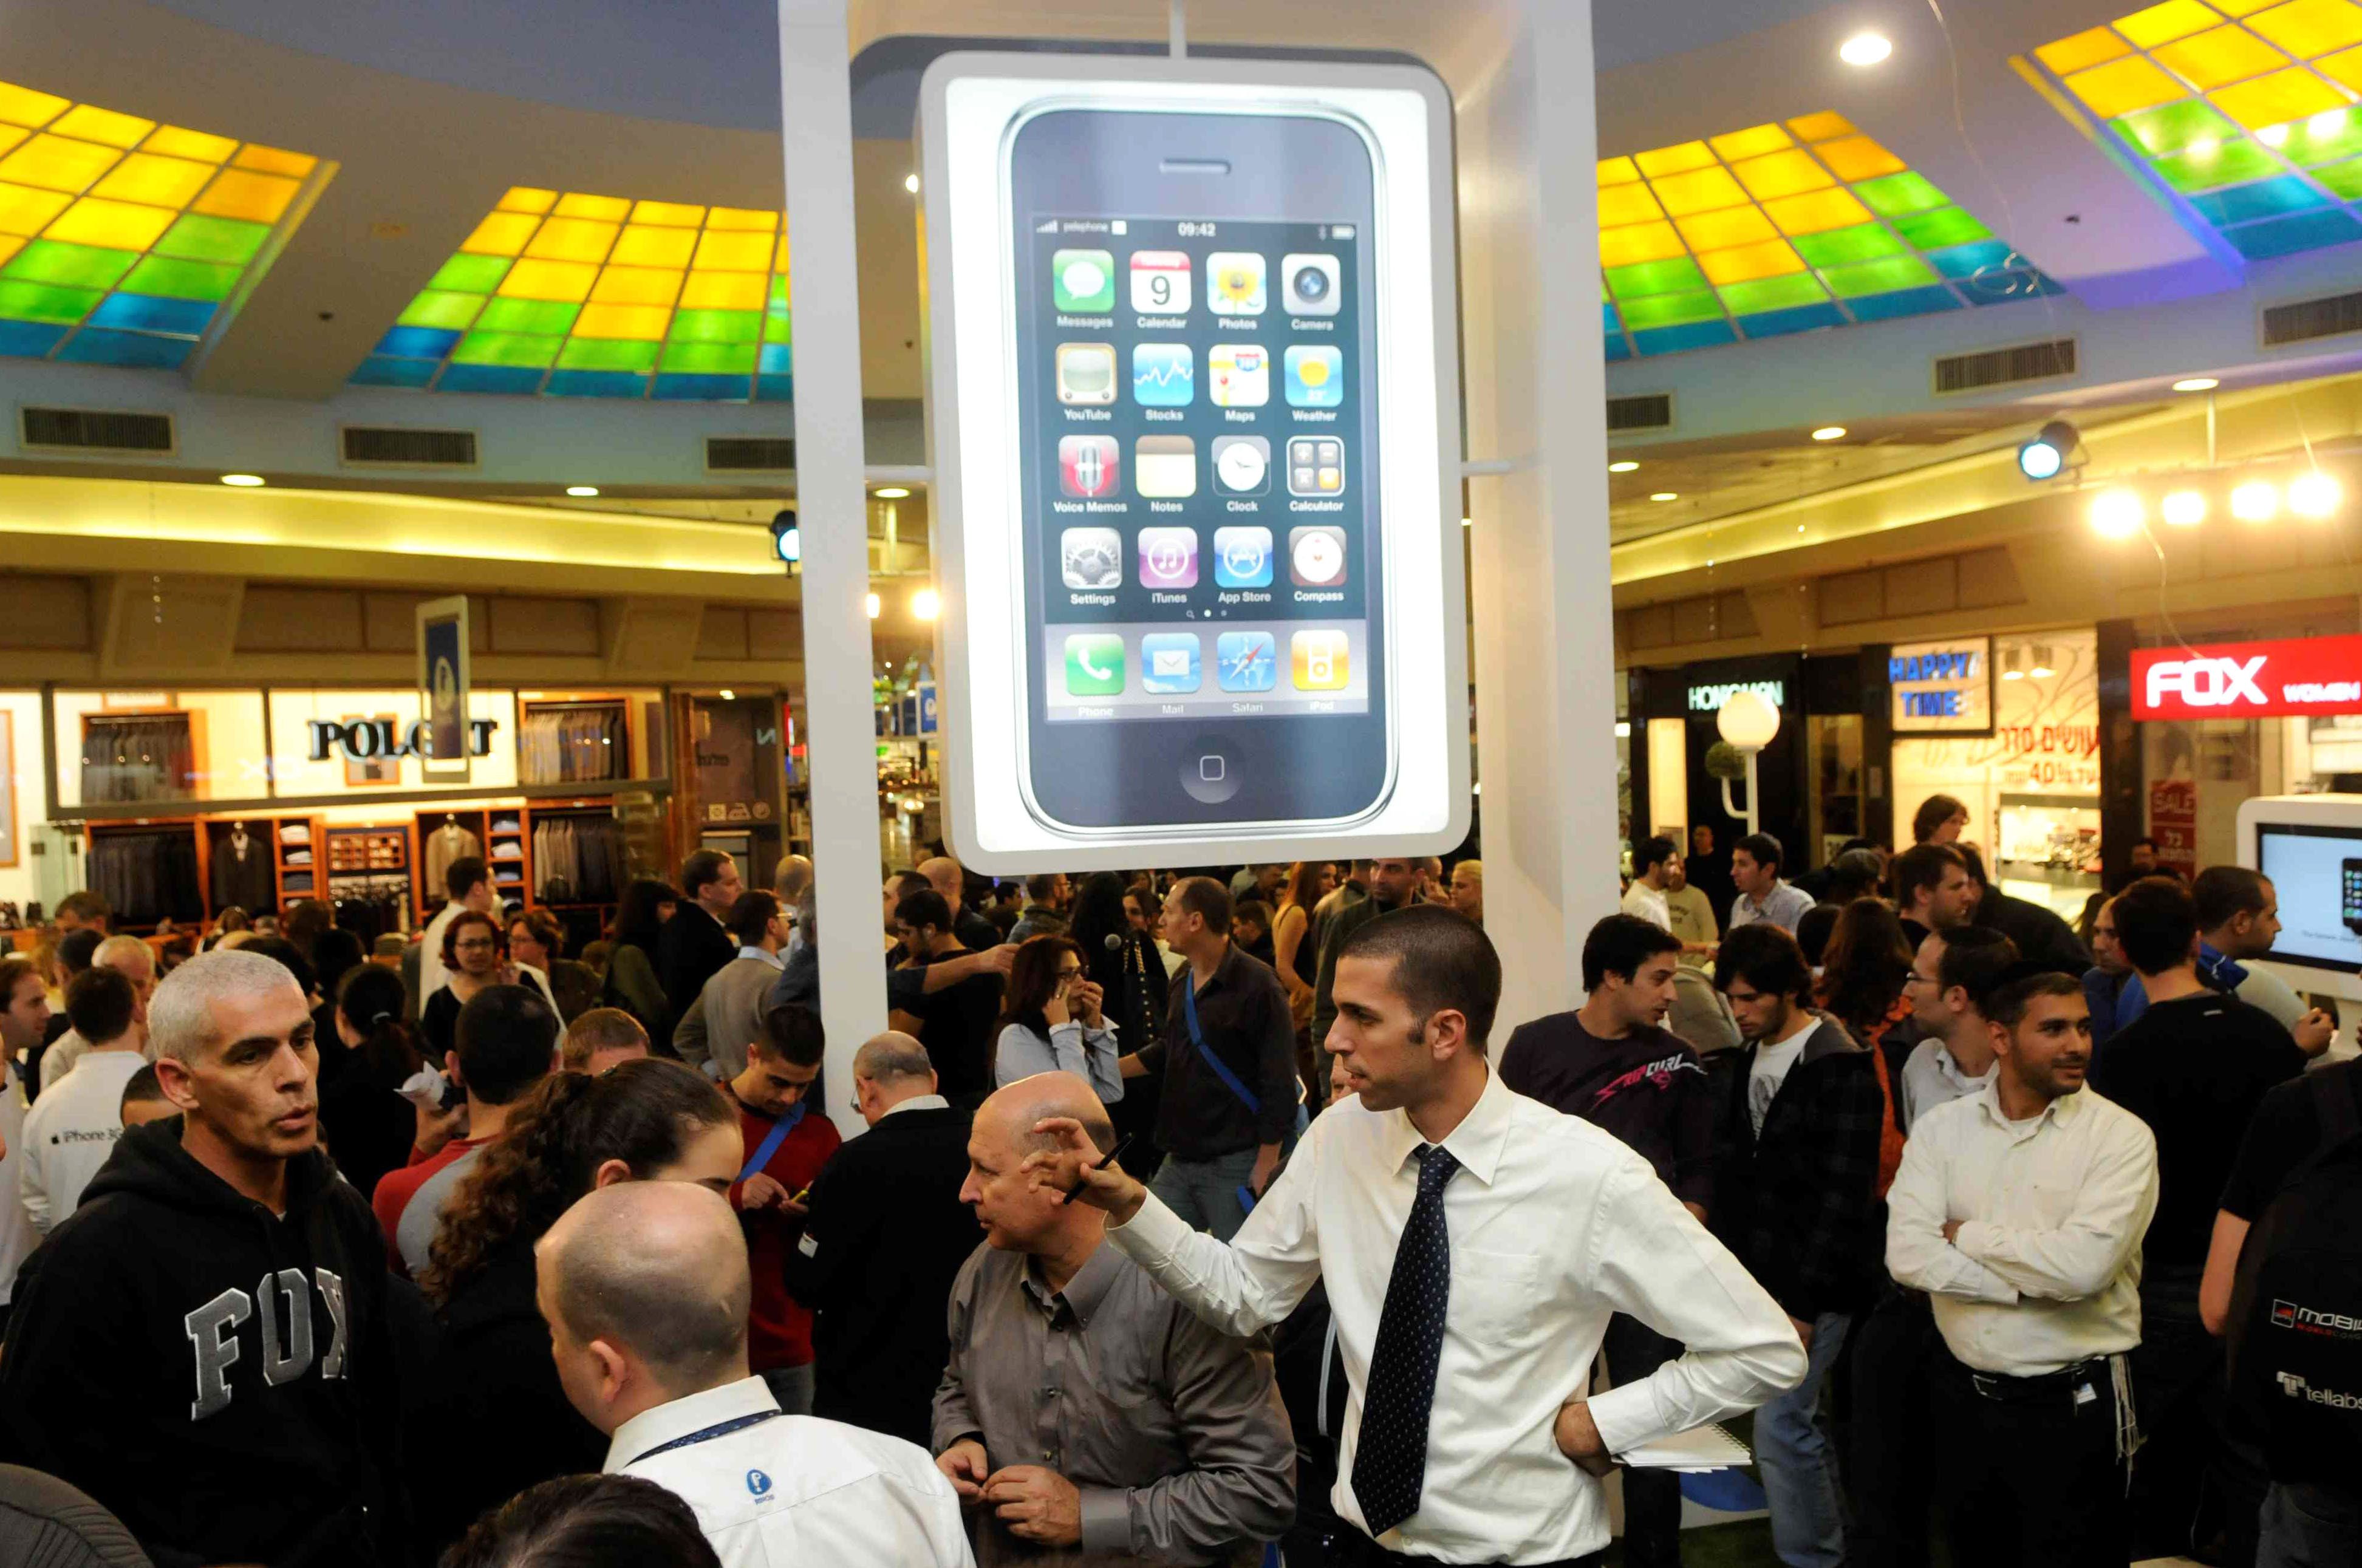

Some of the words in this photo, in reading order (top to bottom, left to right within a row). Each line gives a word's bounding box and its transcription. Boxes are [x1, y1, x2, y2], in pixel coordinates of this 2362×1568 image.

[1178, 222, 1217, 237] 09:42
[1150, 275, 1172, 306] 9
[1057, 315, 1113, 329] Messages
[1137, 316, 1187, 329] Calendar
[1218, 318, 1258, 330] Photos
[1291, 319, 1334, 331] Camera
[1064, 409, 1111, 421] YouTube
[1145, 409, 1184, 421] Stocks
[1225, 410, 1255, 424] Maps
[1292, 409, 1337, 421] Weather
[1053, 501, 1084, 513] Voice
[1090, 501, 1127, 513] Memos
[1150, 501, 1183, 513] Notes
[1226, 500, 1258, 513] Clock
[1289, 500, 1344, 513] Calculator
[1070, 592, 1116, 605] Settings
[1152, 592, 1187, 604] iTunes
[1218, 591, 1240, 605] App
[1242, 591, 1271, 603] Store
[1294, 590, 1344, 604] Compass
[1889, 652, 1968, 684] HAPPY
[2146, 656, 2268, 707] FOX
[2282, 681, 2361, 703] WOMEN
[1162, 704, 1184, 715] Mail
[1232, 703, 1263, 714] Safari
[1309, 701, 1334, 712] iPod
[1901, 690, 1959, 717] TIME
[1078, 706, 1114, 718] Phone
[1645, 1052, 1702, 1077] CURL
[63, 1129, 106, 1144] iPhone
[185, 1267, 348, 1422] FOX
